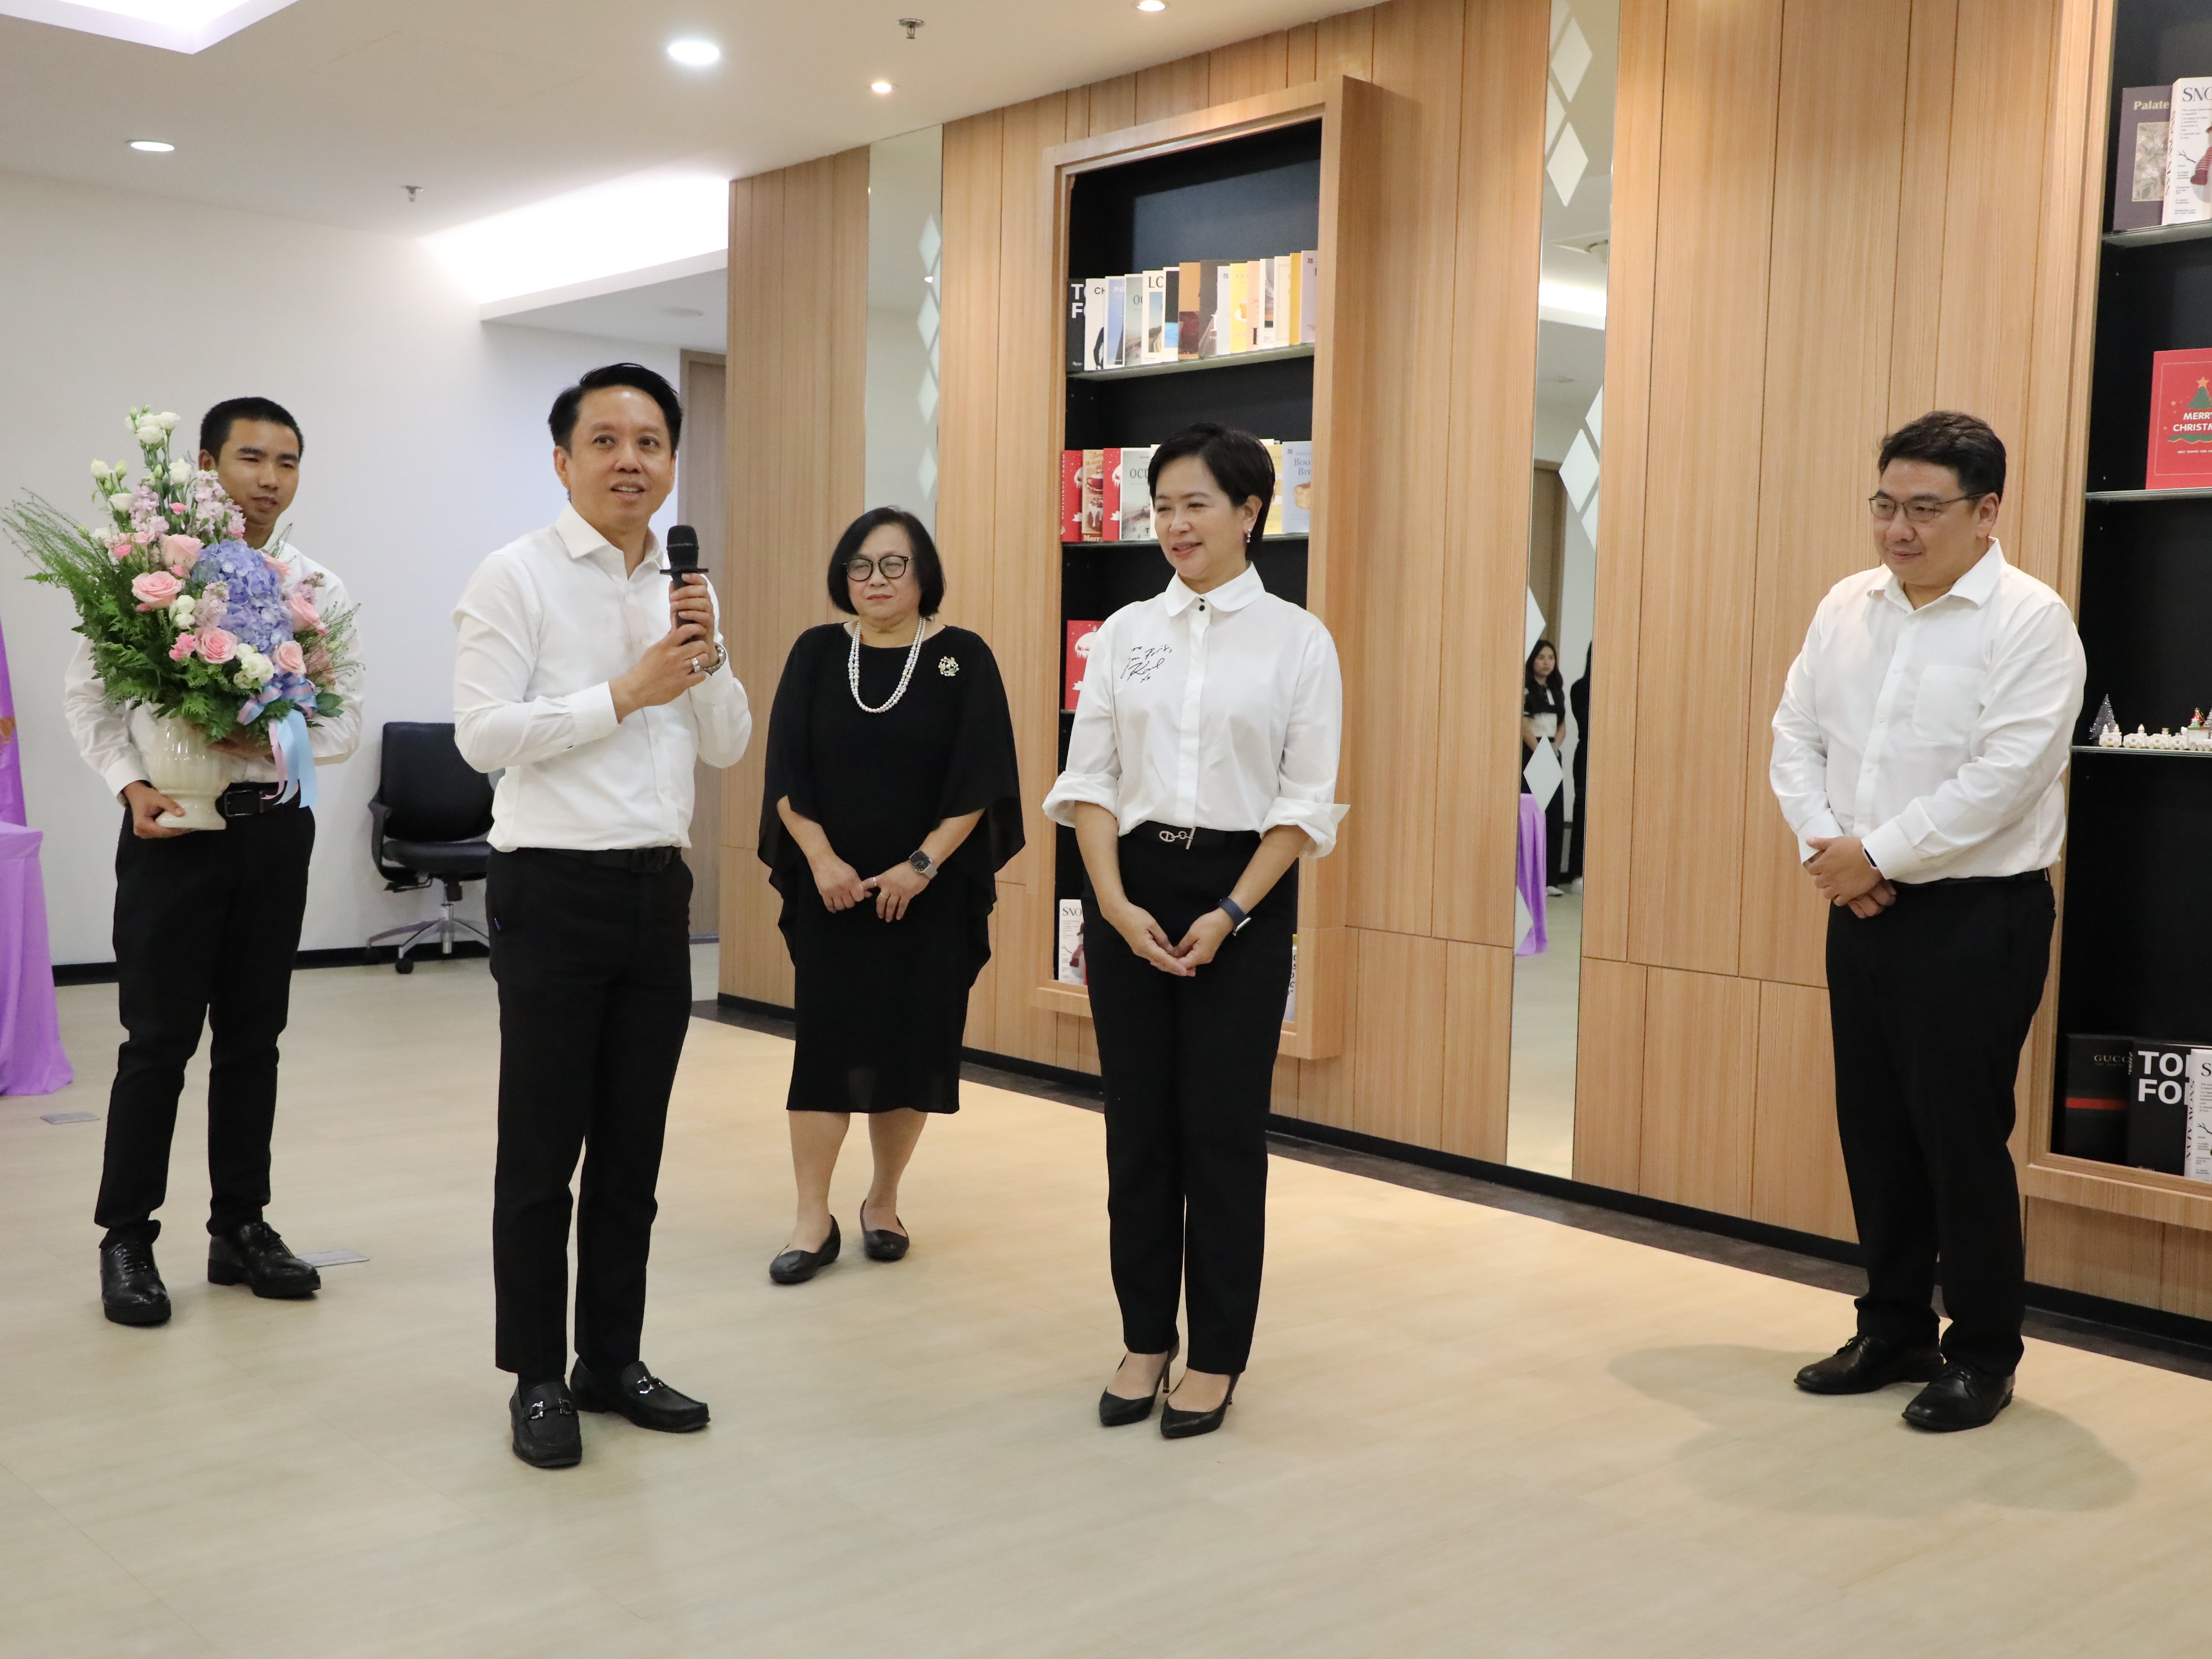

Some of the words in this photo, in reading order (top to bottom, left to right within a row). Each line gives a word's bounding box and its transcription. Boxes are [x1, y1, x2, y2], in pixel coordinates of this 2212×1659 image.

[2133, 99, 2170, 110] Palate
[1071, 283, 1086, 300] T
[1071, 302, 1085, 318] F
[2183, 412, 2212, 420] MERR
[1294, 458, 1311, 466] Boo
[1063, 907, 1082, 916] SNO
[2138, 1051, 2191, 1078] TO
[2201, 1063, 2212, 1076] S
[2138, 1078, 2189, 1105] FO
